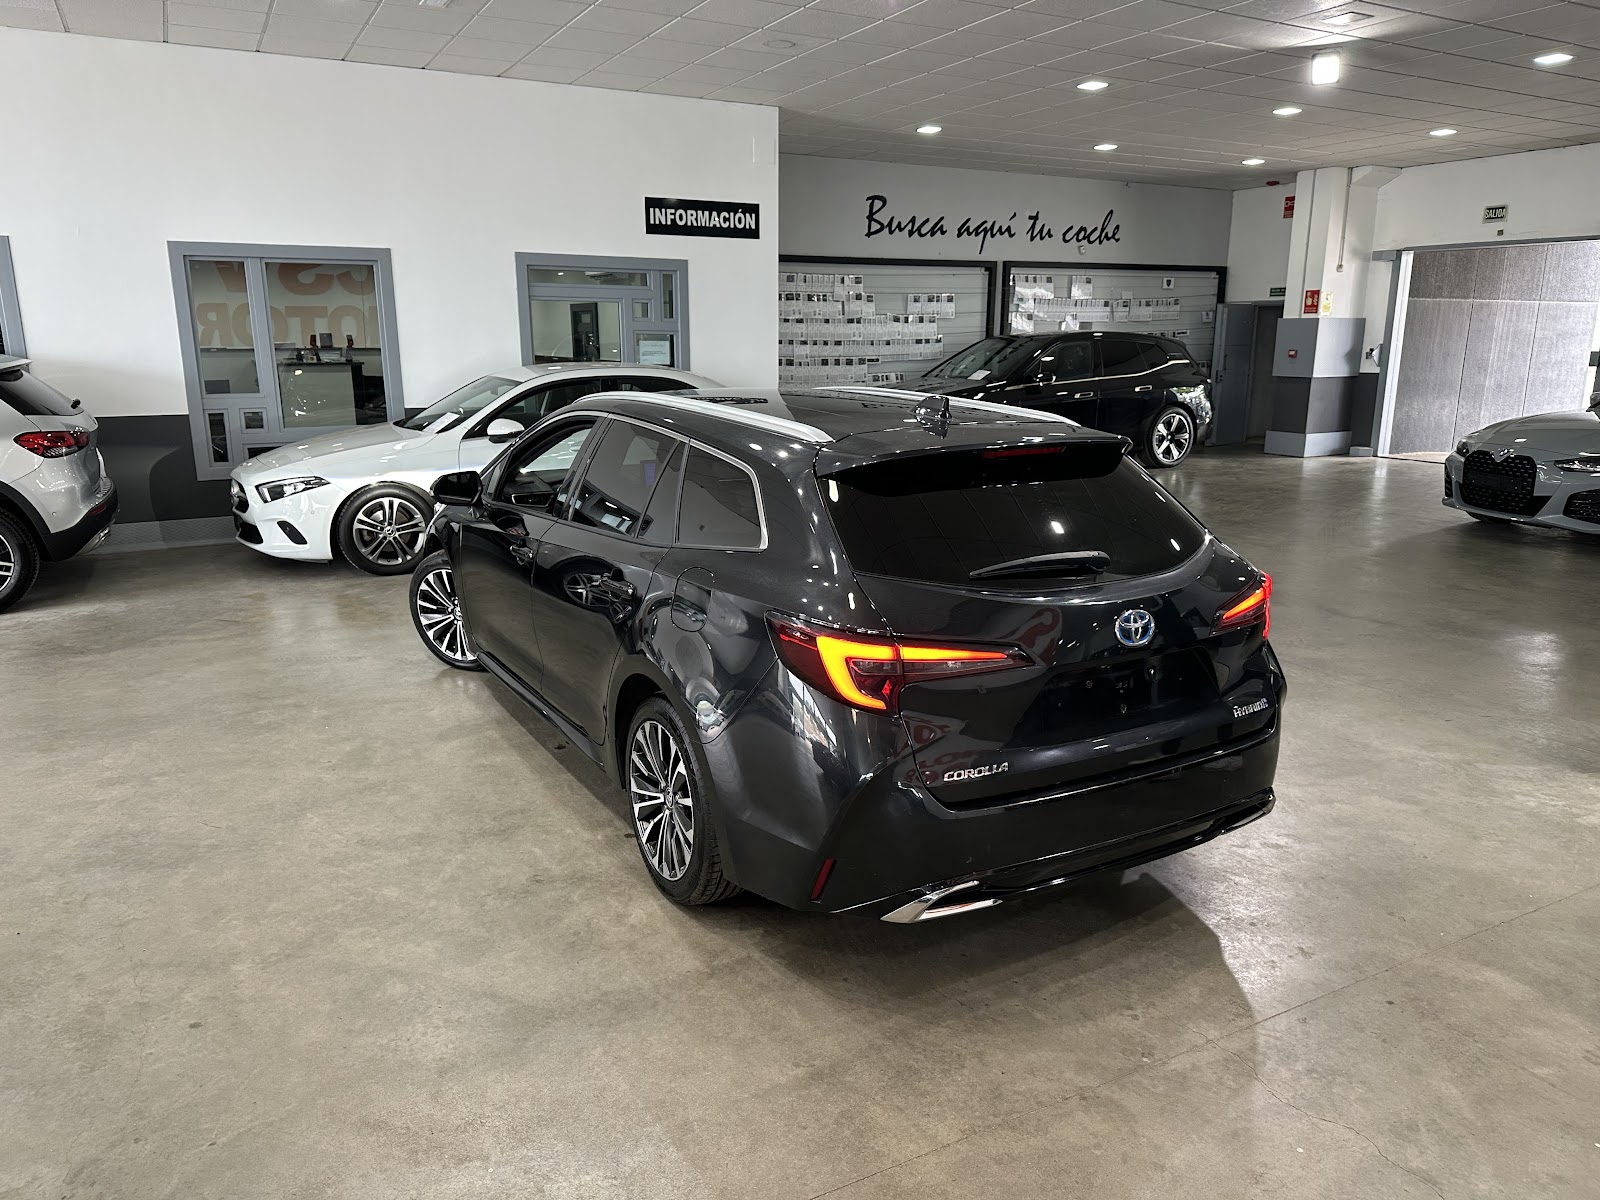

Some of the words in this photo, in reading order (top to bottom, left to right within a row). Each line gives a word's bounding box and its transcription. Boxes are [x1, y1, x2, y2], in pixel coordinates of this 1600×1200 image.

[649, 208, 756, 230] INFORMACIÓN
[1484, 208, 1506, 219] SALIDA
[865, 194, 948, 239] Busca
[956, 212, 1017, 256] aquí
[1027, 211, 1054, 242] tu
[1062, 209, 1121, 246] coche
[943, 761, 1009, 782] COROLLA
